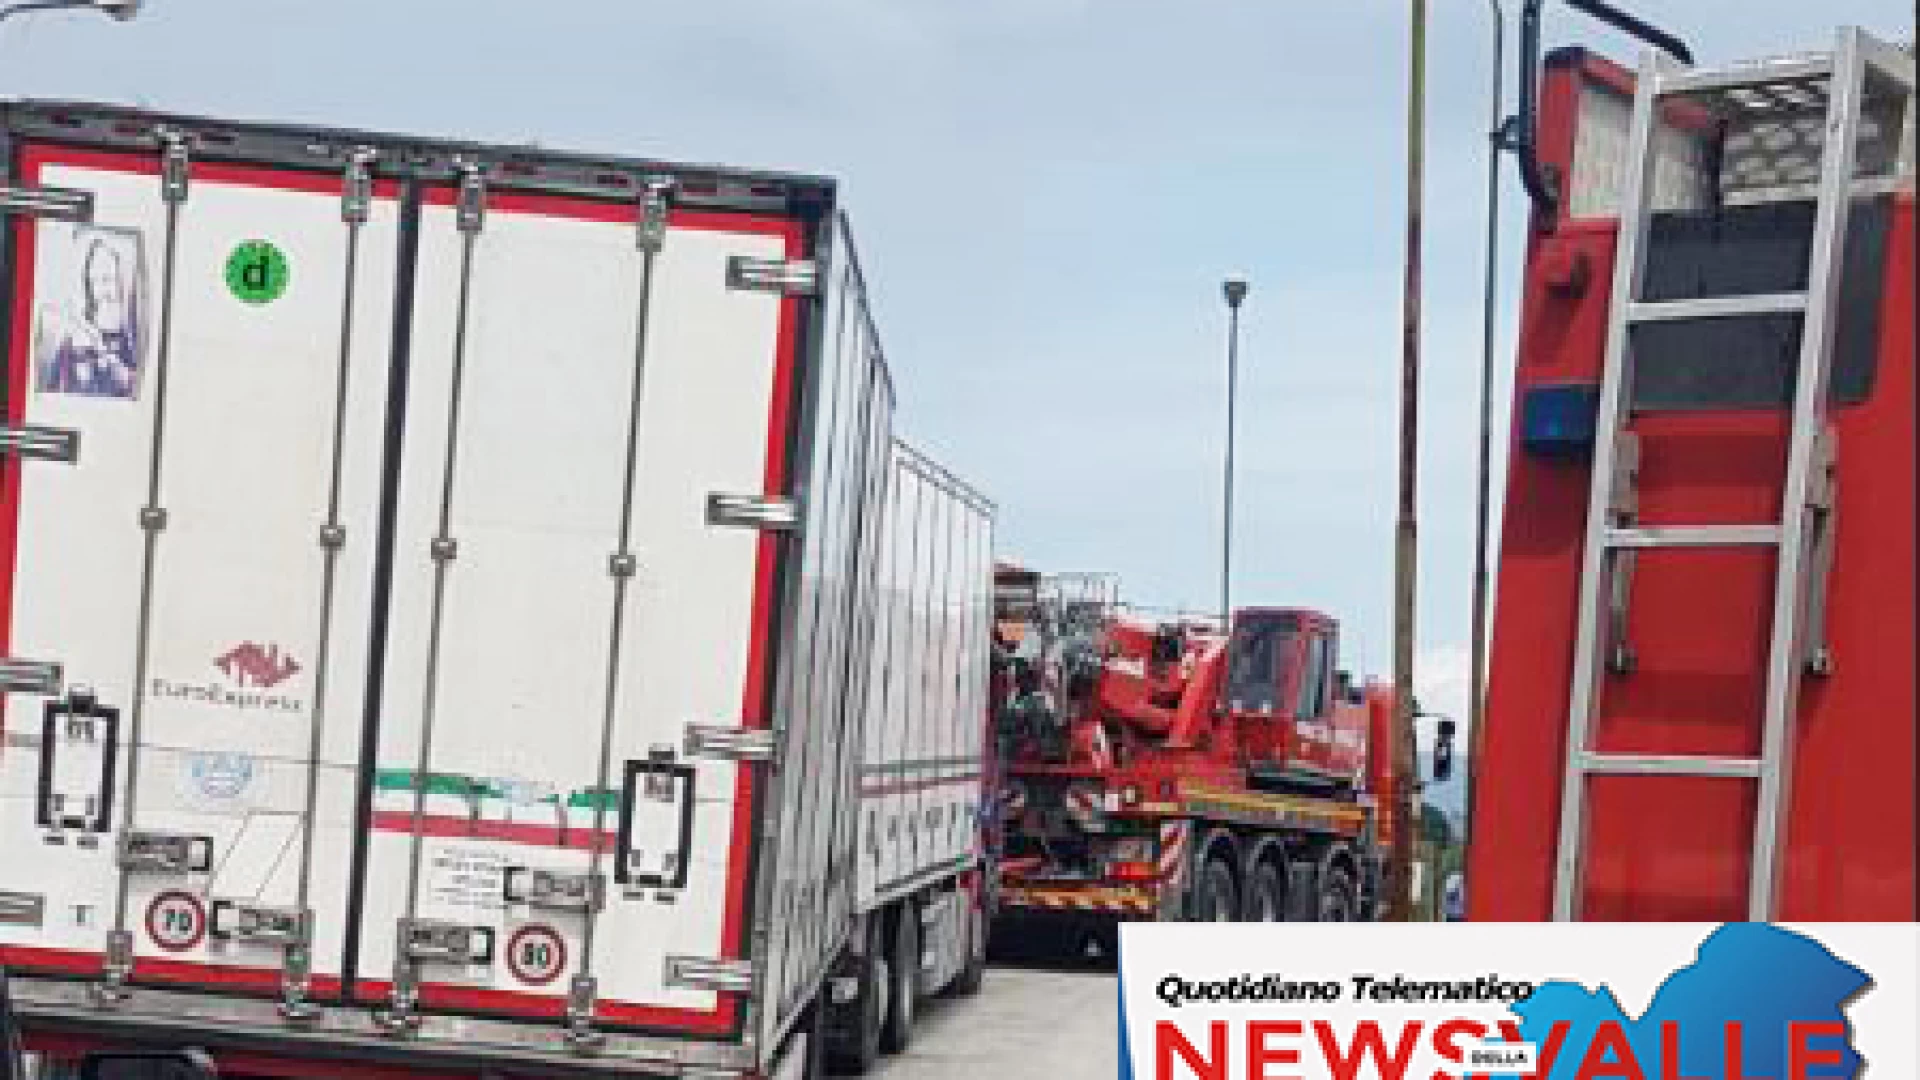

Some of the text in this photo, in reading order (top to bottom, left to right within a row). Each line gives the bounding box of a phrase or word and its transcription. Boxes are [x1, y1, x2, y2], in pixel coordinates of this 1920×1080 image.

[242, 254, 270, 291] d
[161, 908, 193, 935] 70
[520, 942, 552, 969] 80
